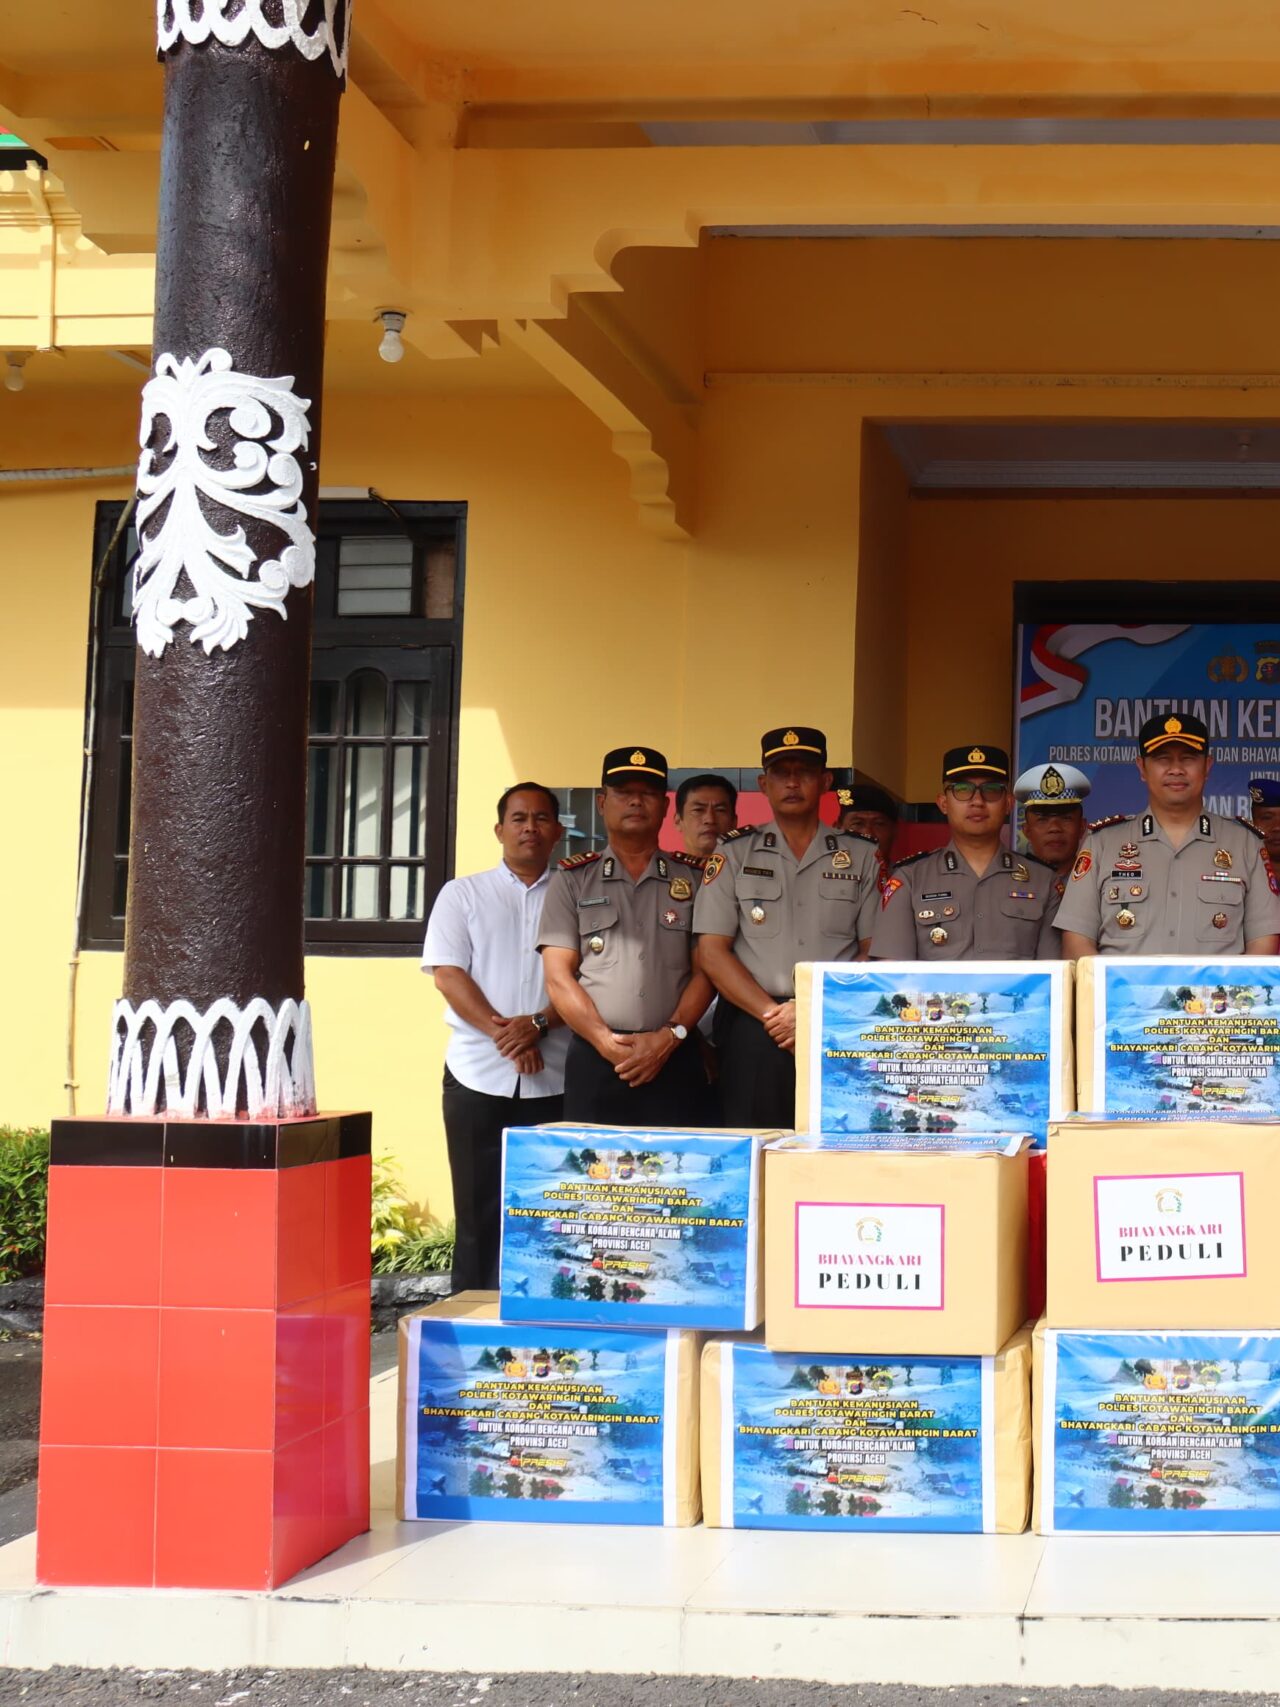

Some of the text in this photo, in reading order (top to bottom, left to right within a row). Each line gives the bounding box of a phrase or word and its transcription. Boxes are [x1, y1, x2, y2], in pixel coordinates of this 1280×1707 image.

[1049, 746, 1091, 762] POLRES
[1216, 747, 1239, 762] DAN
[898, 1035, 972, 1043] KOTAWARINGIN
[1110, 1044, 1177, 1052] BHAYANGKARI
[560, 1183, 686, 1196] BANTUAN KEMANUSIAAN
[543, 1192, 702, 1206] POLRES KOTAWARINGIN BARAT
[508, 1208, 744, 1227] BHAYANGKARI CABANG KOTAWARINGIN BARAT
[1119, 1223, 1223, 1238] BHAYANGKARI
[592, 1238, 650, 1250] PROVINSI ACEH
[1120, 1242, 1223, 1262] PEDULI
[818, 1253, 922, 1266] BHAYANGKARI
[818, 1272, 921, 1290] PEDULI
[475, 1382, 602, 1393] BANTUAN KEMANUSIAAN
[459, 1391, 618, 1403] POLRES KOTAWARINGIN BARAT
[1114, 1395, 1246, 1404] BANTUAN KEMANUSIAAN
[842, 1400, 918, 1408] KEMANUSIAAN
[1098, 1404, 1262, 1414] POLRES KOTAWARINGIN BARAT
[423, 1408, 659, 1423] BHAYANGKARI CABANG KOTAWARINGIN BARAT
[775, 1409, 935, 1418] POLRES KOTAWARINGIN BARAT
[740, 1426, 978, 1437] BHAYANGKARI CABANG KOTAWARINGIN BARAT
[1060, 1422, 1135, 1430] BHAYANGKARI
[1138, 1424, 1182, 1432] CABANG
[1185, 1424, 1267, 1433] KOTAWARINGIN
[510, 1436, 568, 1448] PROVINSI ACEH
[827, 1453, 885, 1464] PROVINSI ACEH
[1151, 1449, 1211, 1460] PROVINSI ACEH
